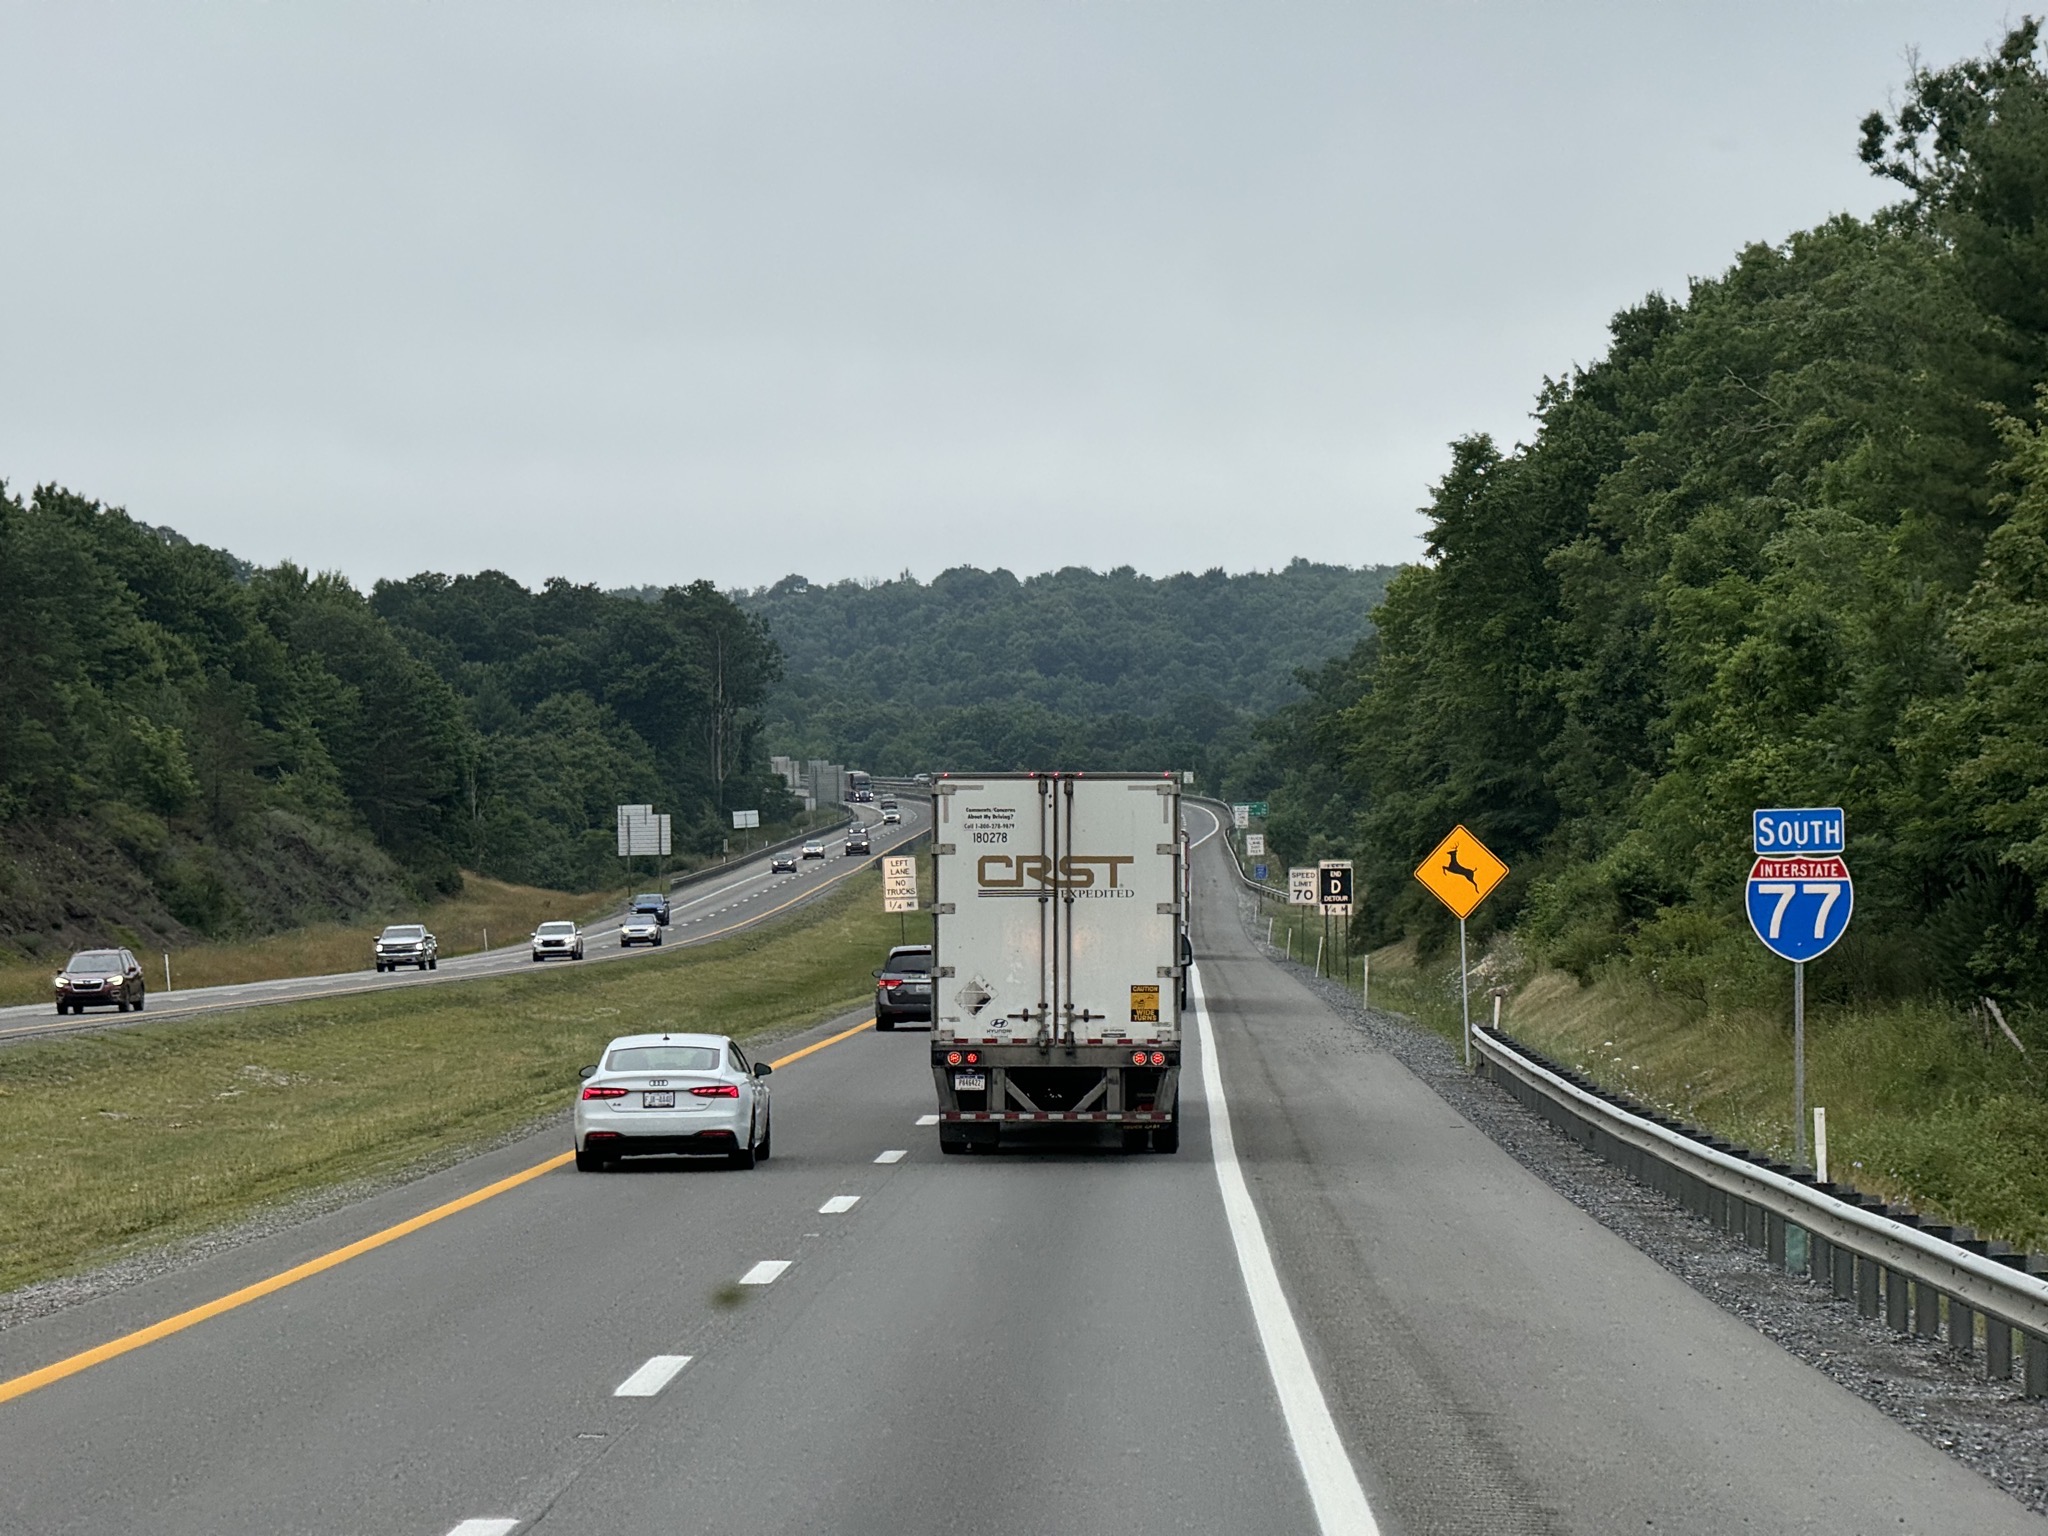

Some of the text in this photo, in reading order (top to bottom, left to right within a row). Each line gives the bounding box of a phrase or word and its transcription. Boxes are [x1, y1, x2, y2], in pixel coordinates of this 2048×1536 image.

[972, 832, 1008, 843] 180278
[1758, 817, 1840, 846] SOUTH
[978, 855, 1135, 888] CRST
[1330, 870, 1342, 878] END
[1760, 863, 1839, 877] INTERSTATE
[1331, 879, 1341, 894] D
[1061, 890, 1135, 899] EXPEDITED
[1293, 889, 1314, 900] 70
[889, 901, 902, 910] 1/4
[1758, 883, 1841, 939] 77
